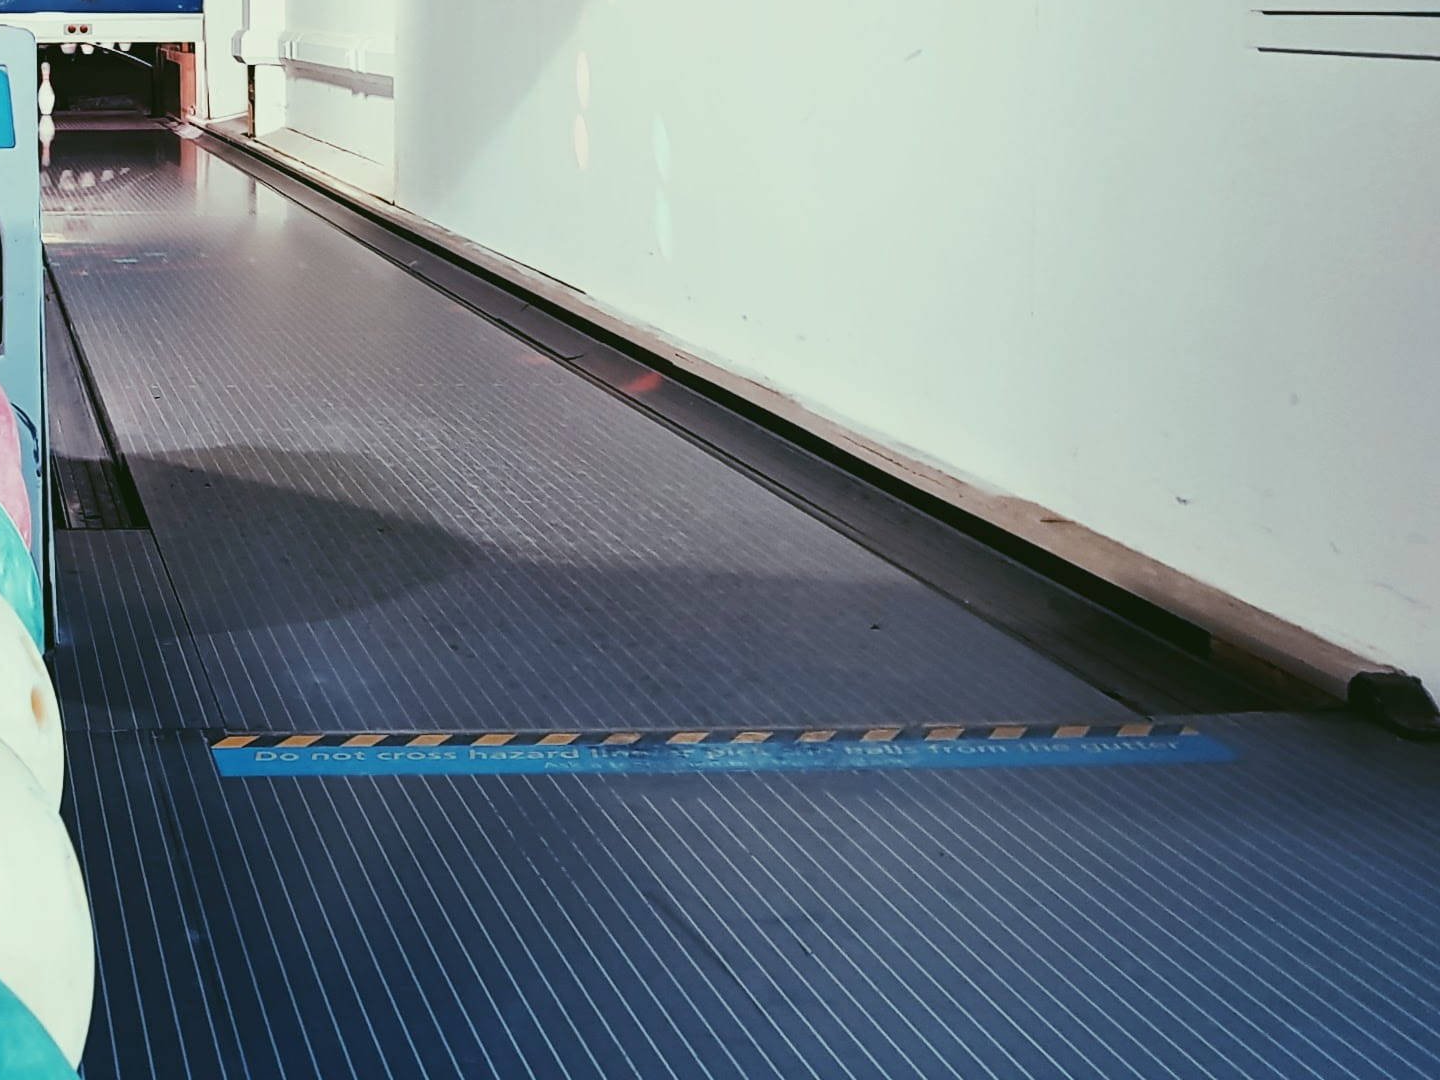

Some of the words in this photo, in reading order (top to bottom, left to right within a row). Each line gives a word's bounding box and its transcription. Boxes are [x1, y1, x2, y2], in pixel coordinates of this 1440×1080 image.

[255, 751, 300, 761] Do
[311, 751, 365, 761] not
[377, 751, 457, 760] cross
[469, 748, 579, 759] hazard
[927, 742, 1008, 754] from
[1019, 741, 1071, 752] the
[1080, 740, 1179, 753] gutter
